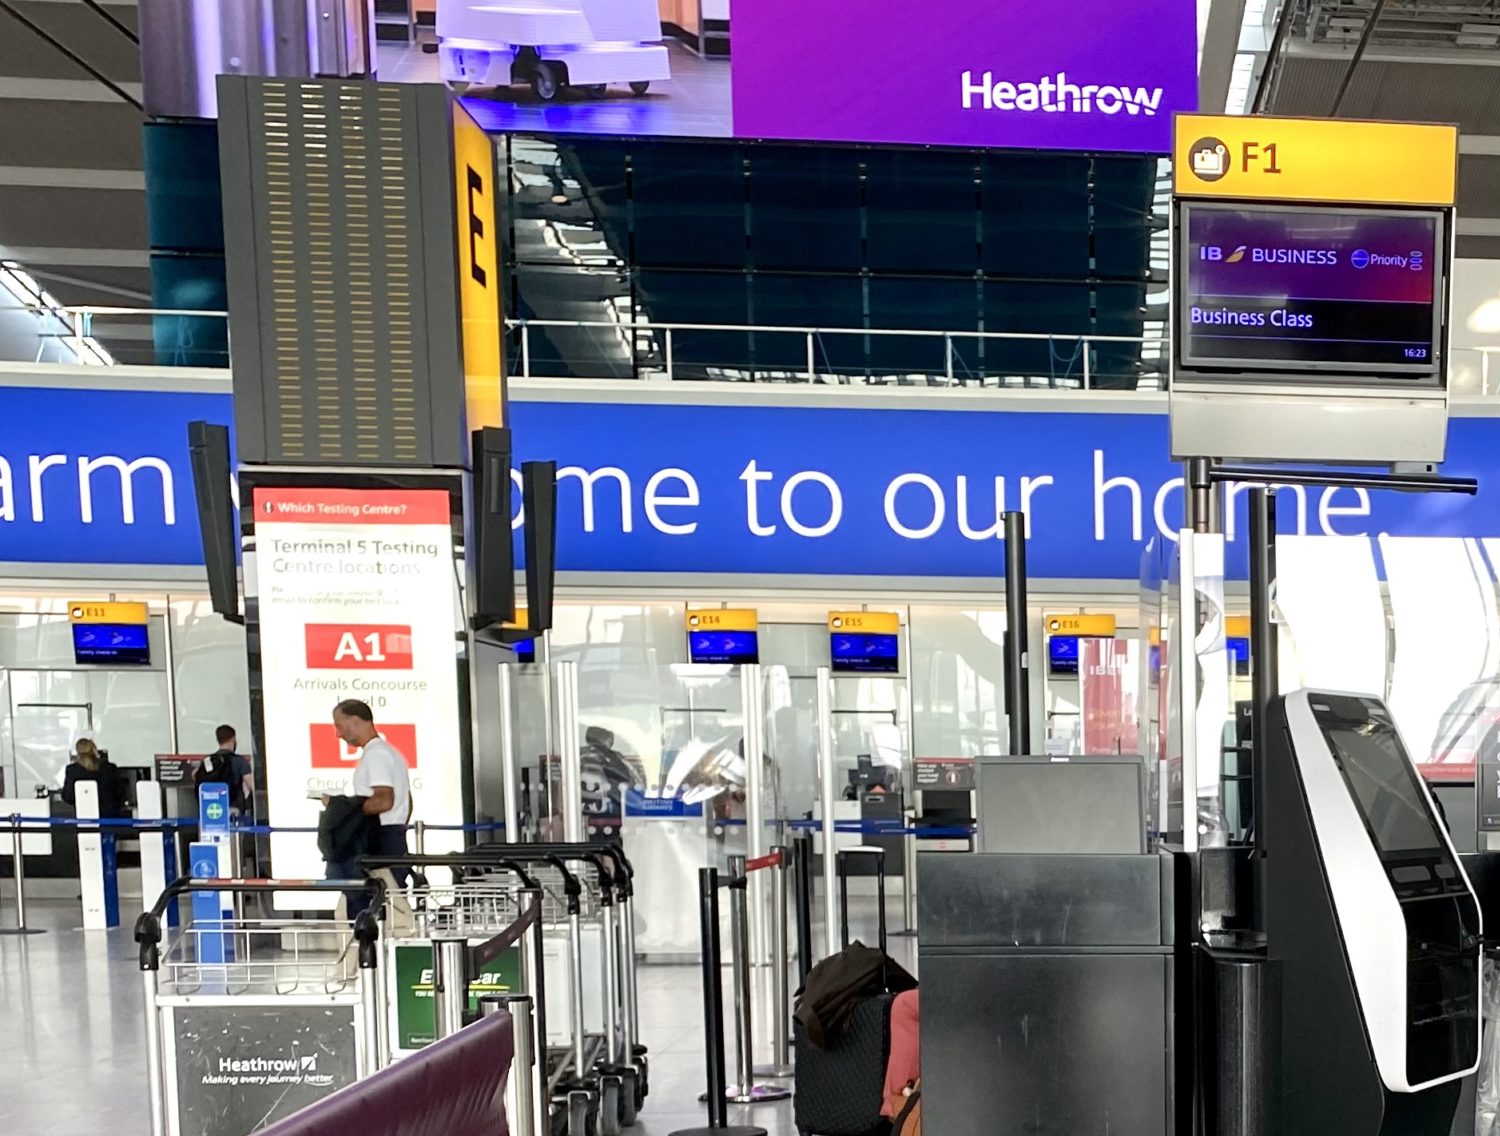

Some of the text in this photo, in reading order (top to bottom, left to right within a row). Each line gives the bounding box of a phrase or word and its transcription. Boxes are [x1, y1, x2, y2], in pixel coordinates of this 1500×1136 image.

[961, 70, 1163, 117] Heathrow
[1241, 142, 1282, 174] F1
[467, 163, 487, 288] E
[1200, 246, 1337, 265] IB BUSINESS
[1371, 253, 1408, 268] Priority
[1191, 307, 1313, 328] Business Class
[1404, 348, 1427, 358] 16:23
[739, 459, 843, 538] to
[884, 473, 1053, 540] our
[277, 501, 408, 517] Which Testing Centre?
[271, 538, 438, 557] Terminal 5 Testing
[273, 558, 421, 575] Centre locations
[702, 615, 720, 625] E14
[845, 618, 863, 627] E15
[1062, 620, 1080, 629] E16
[334, 631, 386, 662] A1
[293, 678, 428, 691] Arrivals Concourse
[218, 1057, 297, 1072] Heathrow
[202, 1074, 334, 1086] Making every journey better
